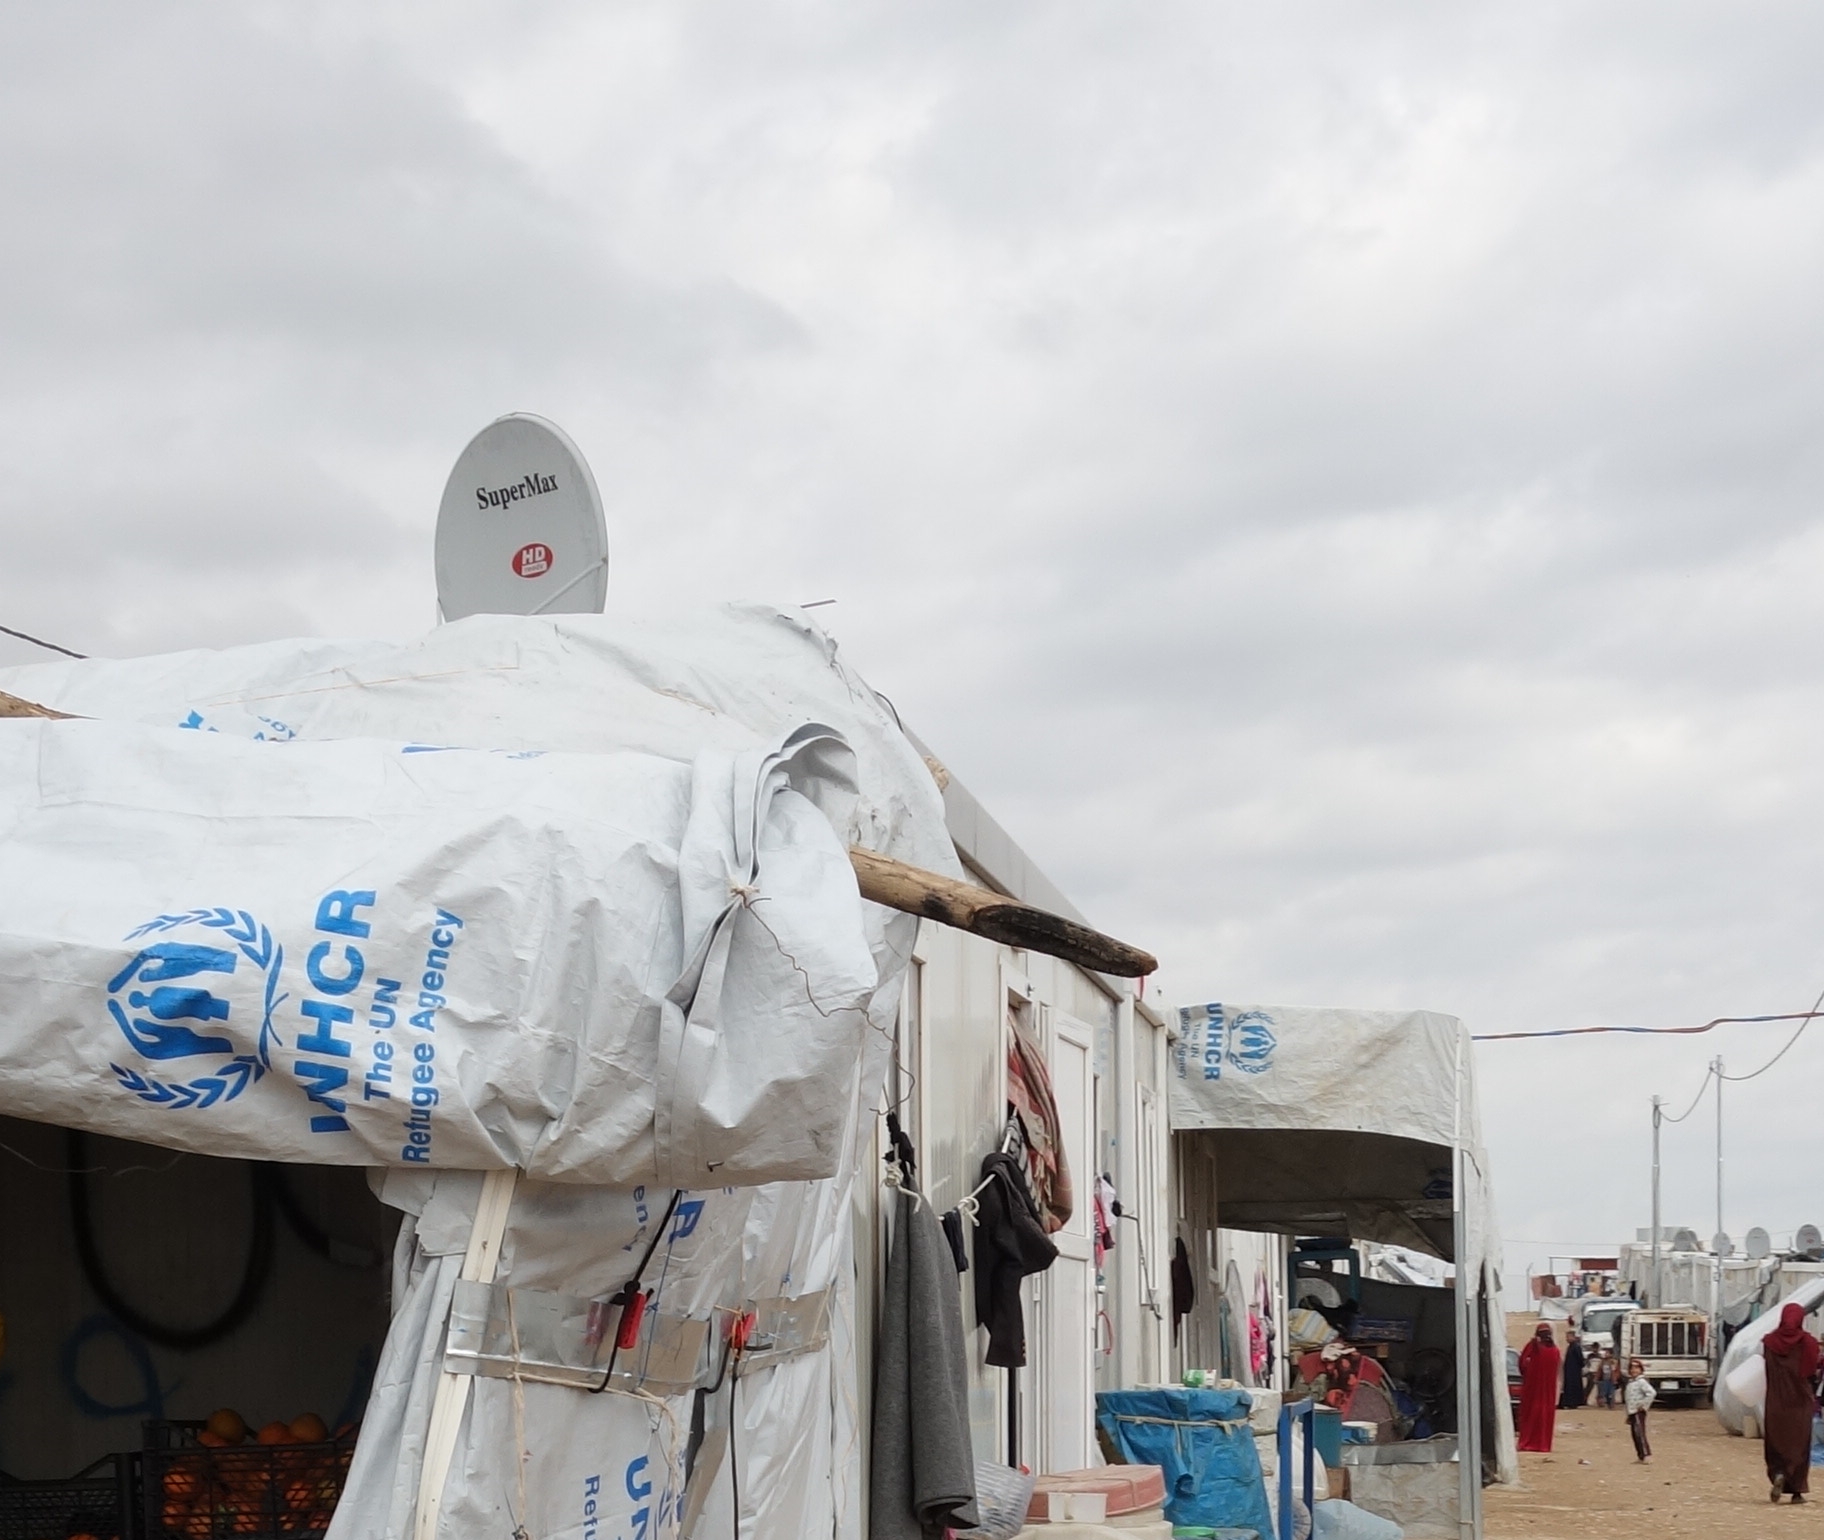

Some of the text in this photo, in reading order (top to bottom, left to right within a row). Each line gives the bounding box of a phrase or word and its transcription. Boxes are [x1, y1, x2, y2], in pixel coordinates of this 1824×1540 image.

[476, 473, 558, 510] SuperMax
[522, 547, 545, 564] HD
[363, 977, 401, 1100] The UN
[402, 908, 464, 1163] Refugee Agency
[1204, 1003, 1223, 1080] UNHCR
